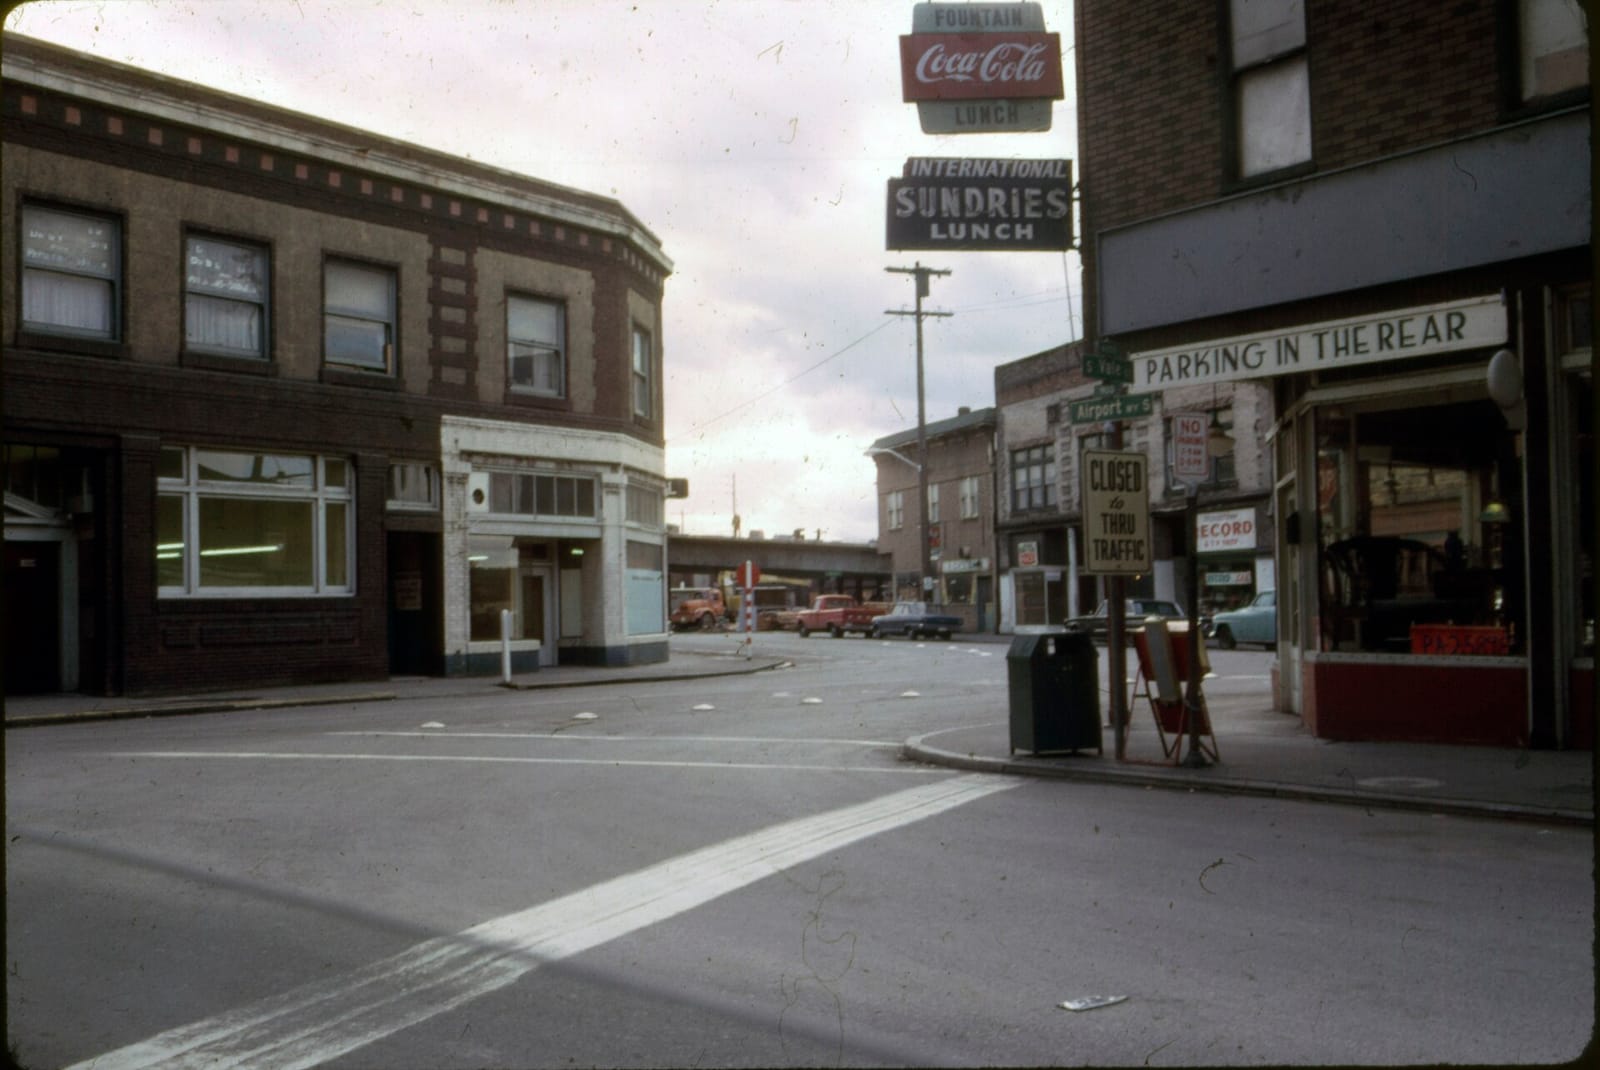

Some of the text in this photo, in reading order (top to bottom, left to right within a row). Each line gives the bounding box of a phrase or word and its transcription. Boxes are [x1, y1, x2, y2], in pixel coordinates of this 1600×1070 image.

[935, 8, 1023, 27] FOUNTAIN
[915, 43, 1048, 83] Coca-Cola
[955, 106, 1019, 125] LUNCH
[911, 159, 1067, 178] INTERNATIONAL
[896, 186, 1068, 219] SUNDRIES
[930, 223, 1034, 240] LUNCH
[1147, 310, 1468, 385] PARKING IN THE REAR
[1077, 398, 1123, 421] Airport
[1142, 398, 1150, 412] S
[1181, 419, 1200, 434] NO
[1091, 459, 1142, 493] CLOSED
[1109, 496, 1124, 510] to
[1101, 513, 1136, 535] THRU
[1199, 520, 1253, 538] ECORD
[1092, 538, 1145, 561] TRAFFIC
